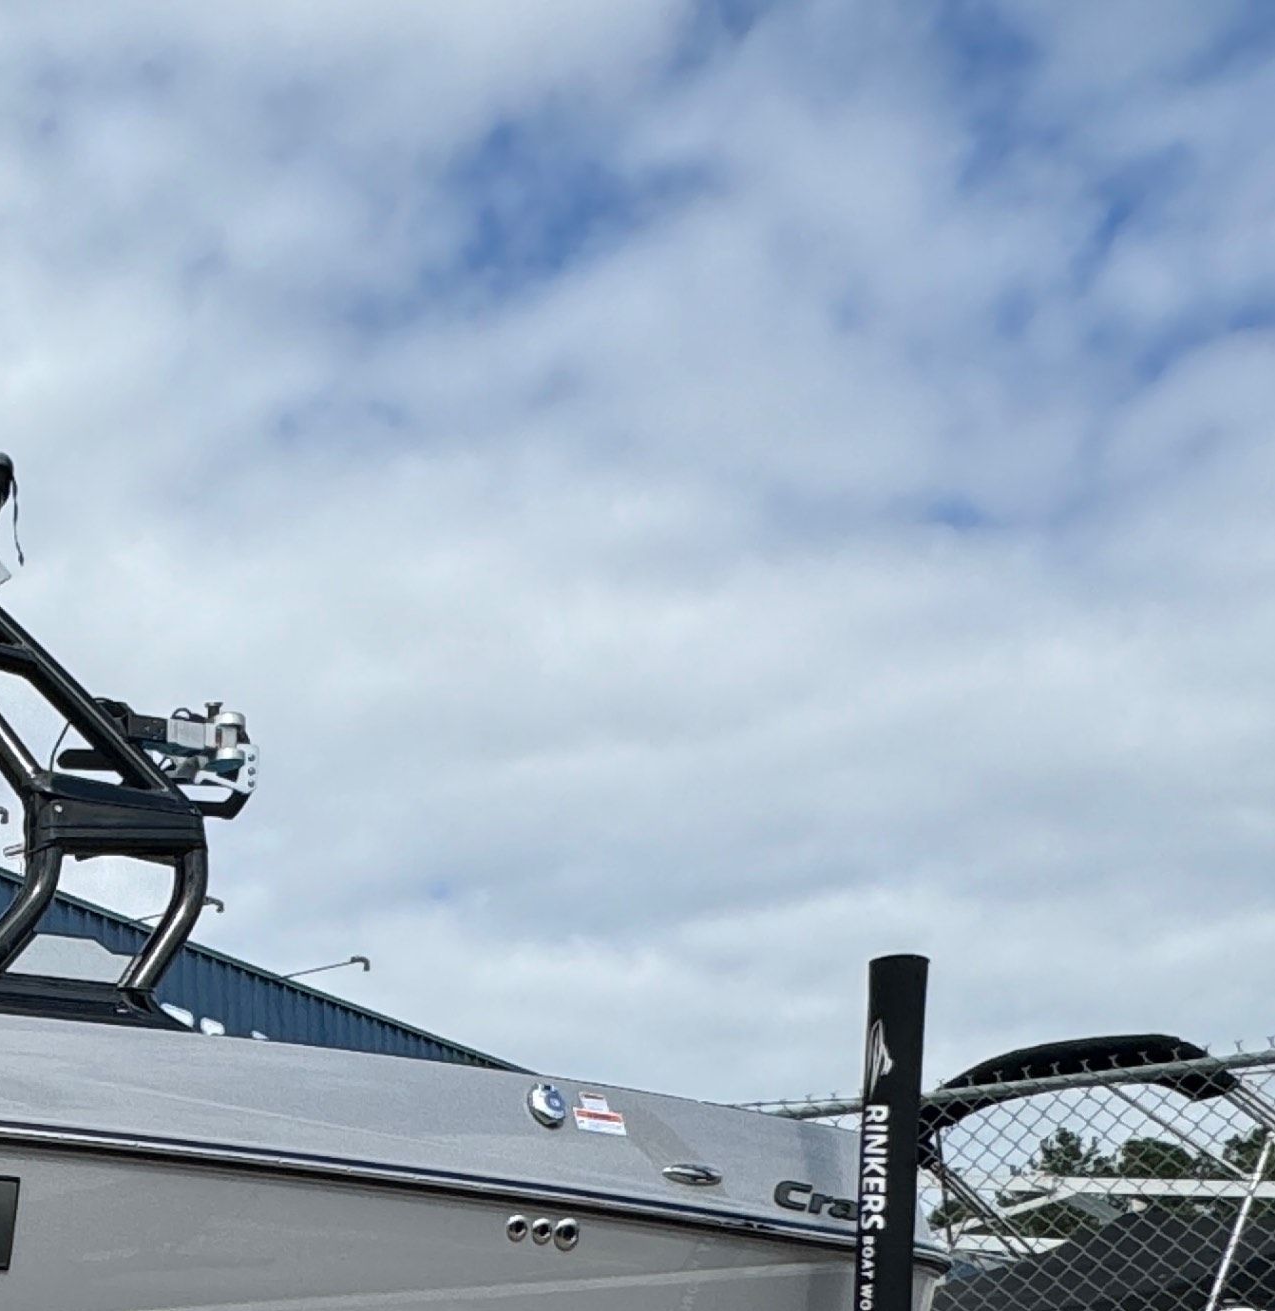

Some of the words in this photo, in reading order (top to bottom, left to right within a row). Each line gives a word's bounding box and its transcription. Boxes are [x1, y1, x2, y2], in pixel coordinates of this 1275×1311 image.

[858, 1104, 890, 1231] RINKERS
[773, 1180, 859, 1221] Cra
[860, 1235, 877, 1280] BOAT
